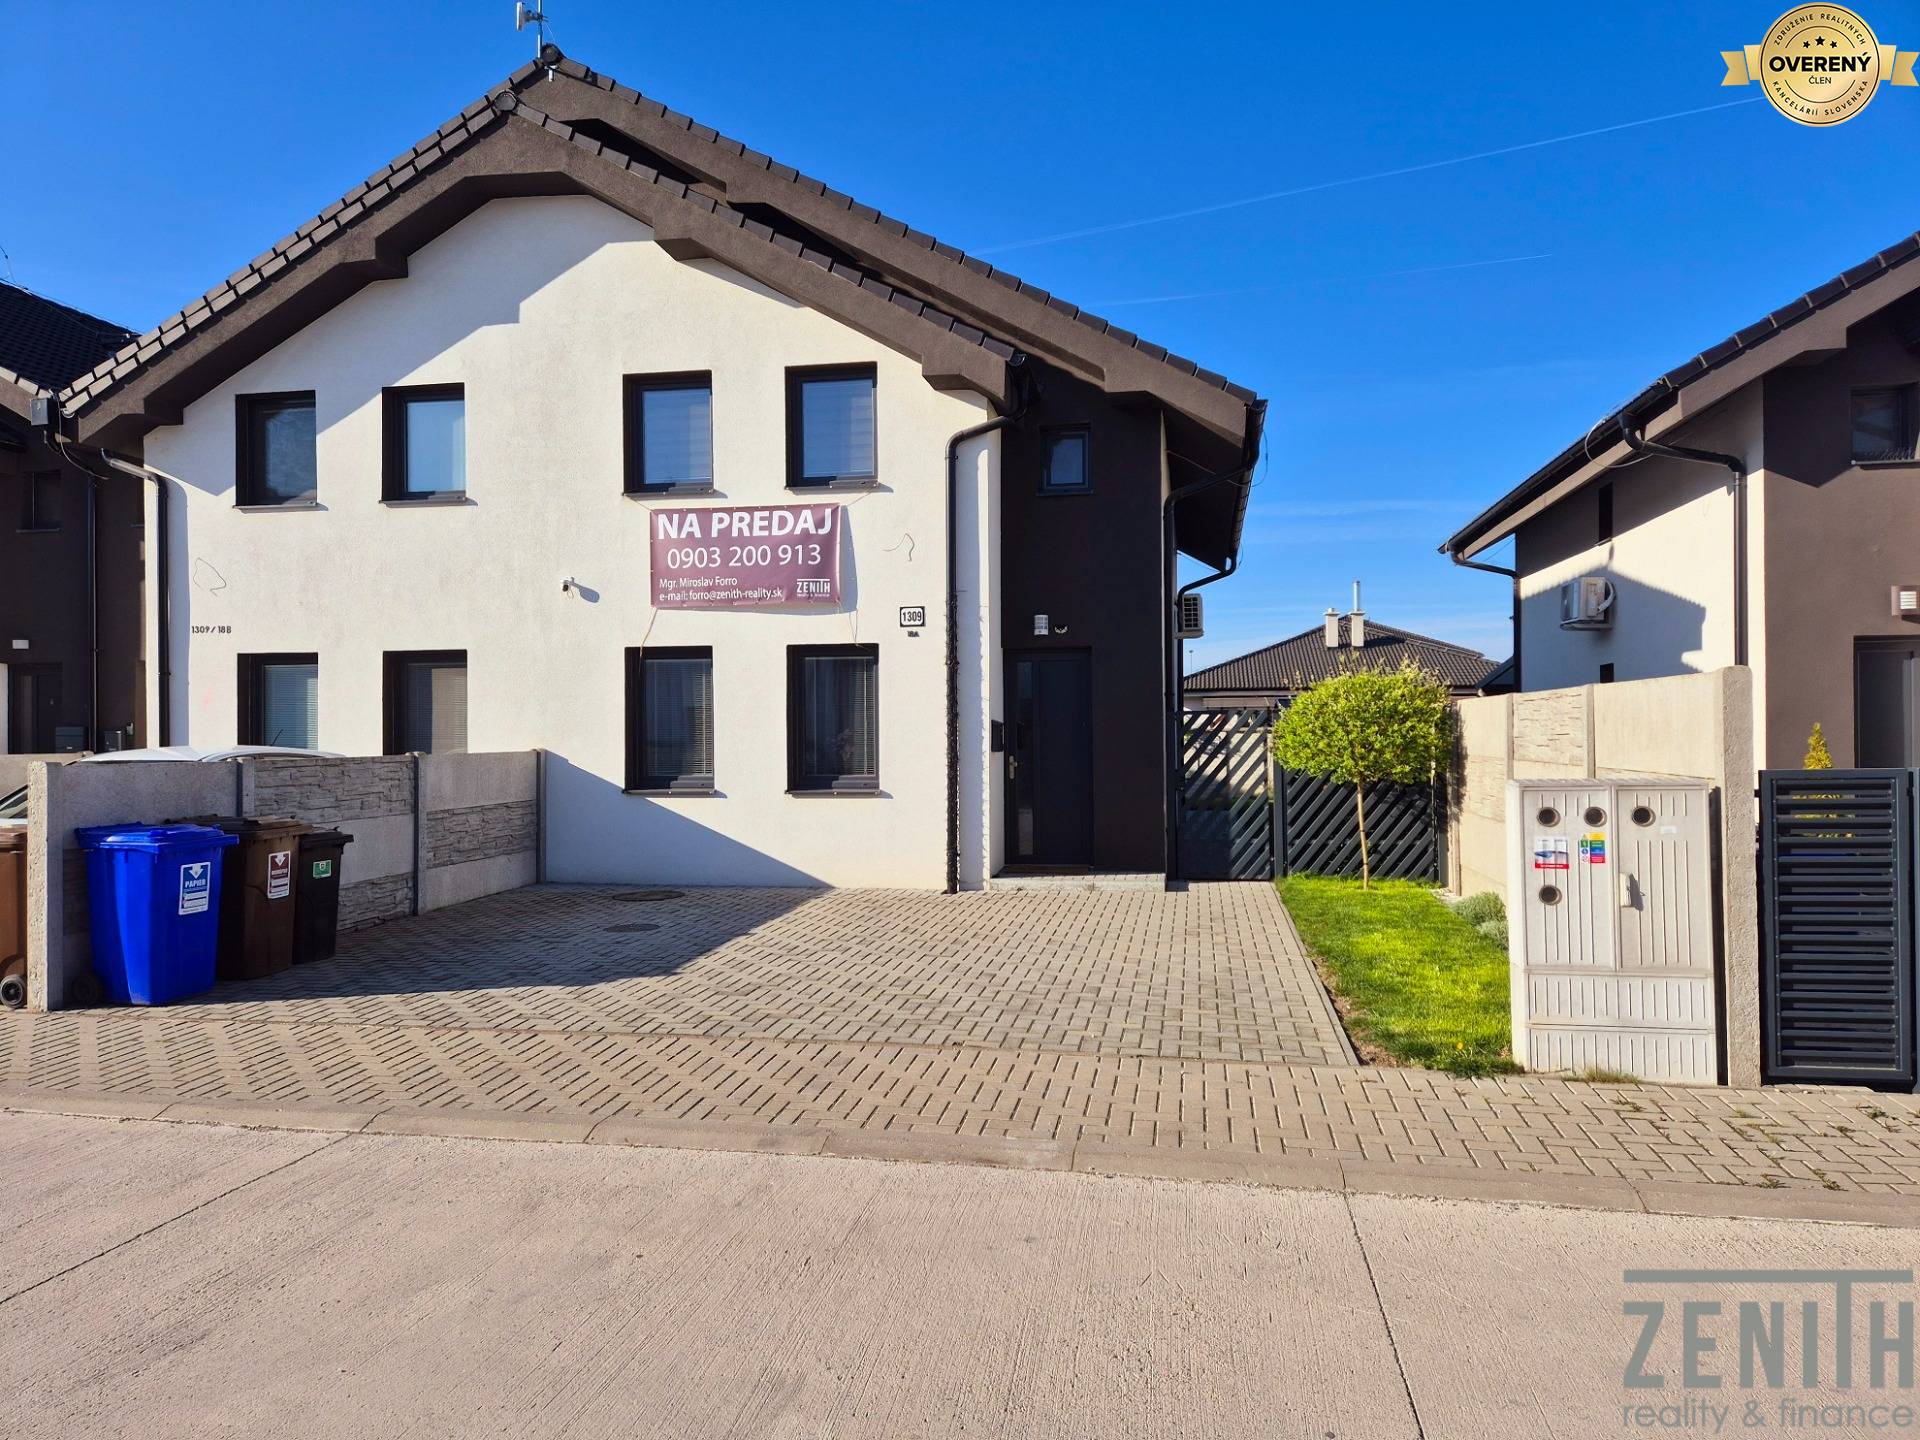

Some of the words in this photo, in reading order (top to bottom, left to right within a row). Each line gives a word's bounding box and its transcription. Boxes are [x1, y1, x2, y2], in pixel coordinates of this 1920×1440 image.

[657, 513, 702, 540] NA
[711, 508, 832, 538] PREDAJ
[667, 547, 721, 569] 0903
[728, 545, 771, 567] 200
[778, 544, 821, 566] 913
[659, 578, 677, 590] Mgr.
[680, 576, 713, 588] Miroslav
[715, 576, 738, 586] Forro
[796, 578, 831, 593] ZENITH
[659, 590, 688, 601] e-mail:
[689, 587, 783, 601] forro@zenith-reality.sk
[902, 611, 922, 622] 1309
